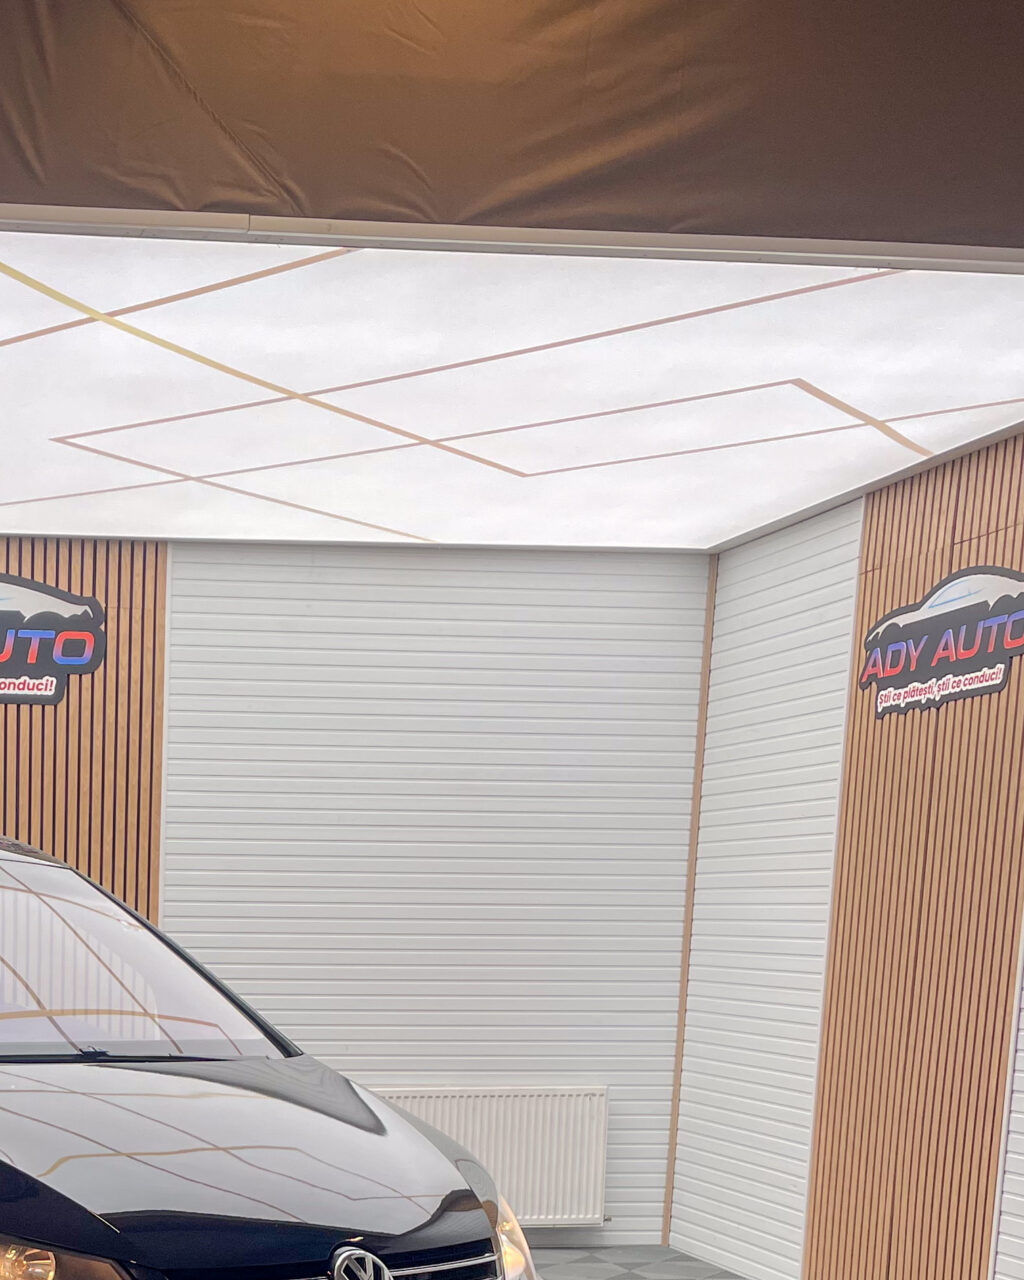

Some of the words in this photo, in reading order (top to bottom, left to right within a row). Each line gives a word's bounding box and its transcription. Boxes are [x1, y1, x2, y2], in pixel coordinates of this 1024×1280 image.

[861, 635, 928, 683] ADY
[931, 609, 1024, 667] AUTO
[892, 692, 902, 702] ce
[951, 679, 962, 689] ce
[963, 666, 1003, 687] conduci!
